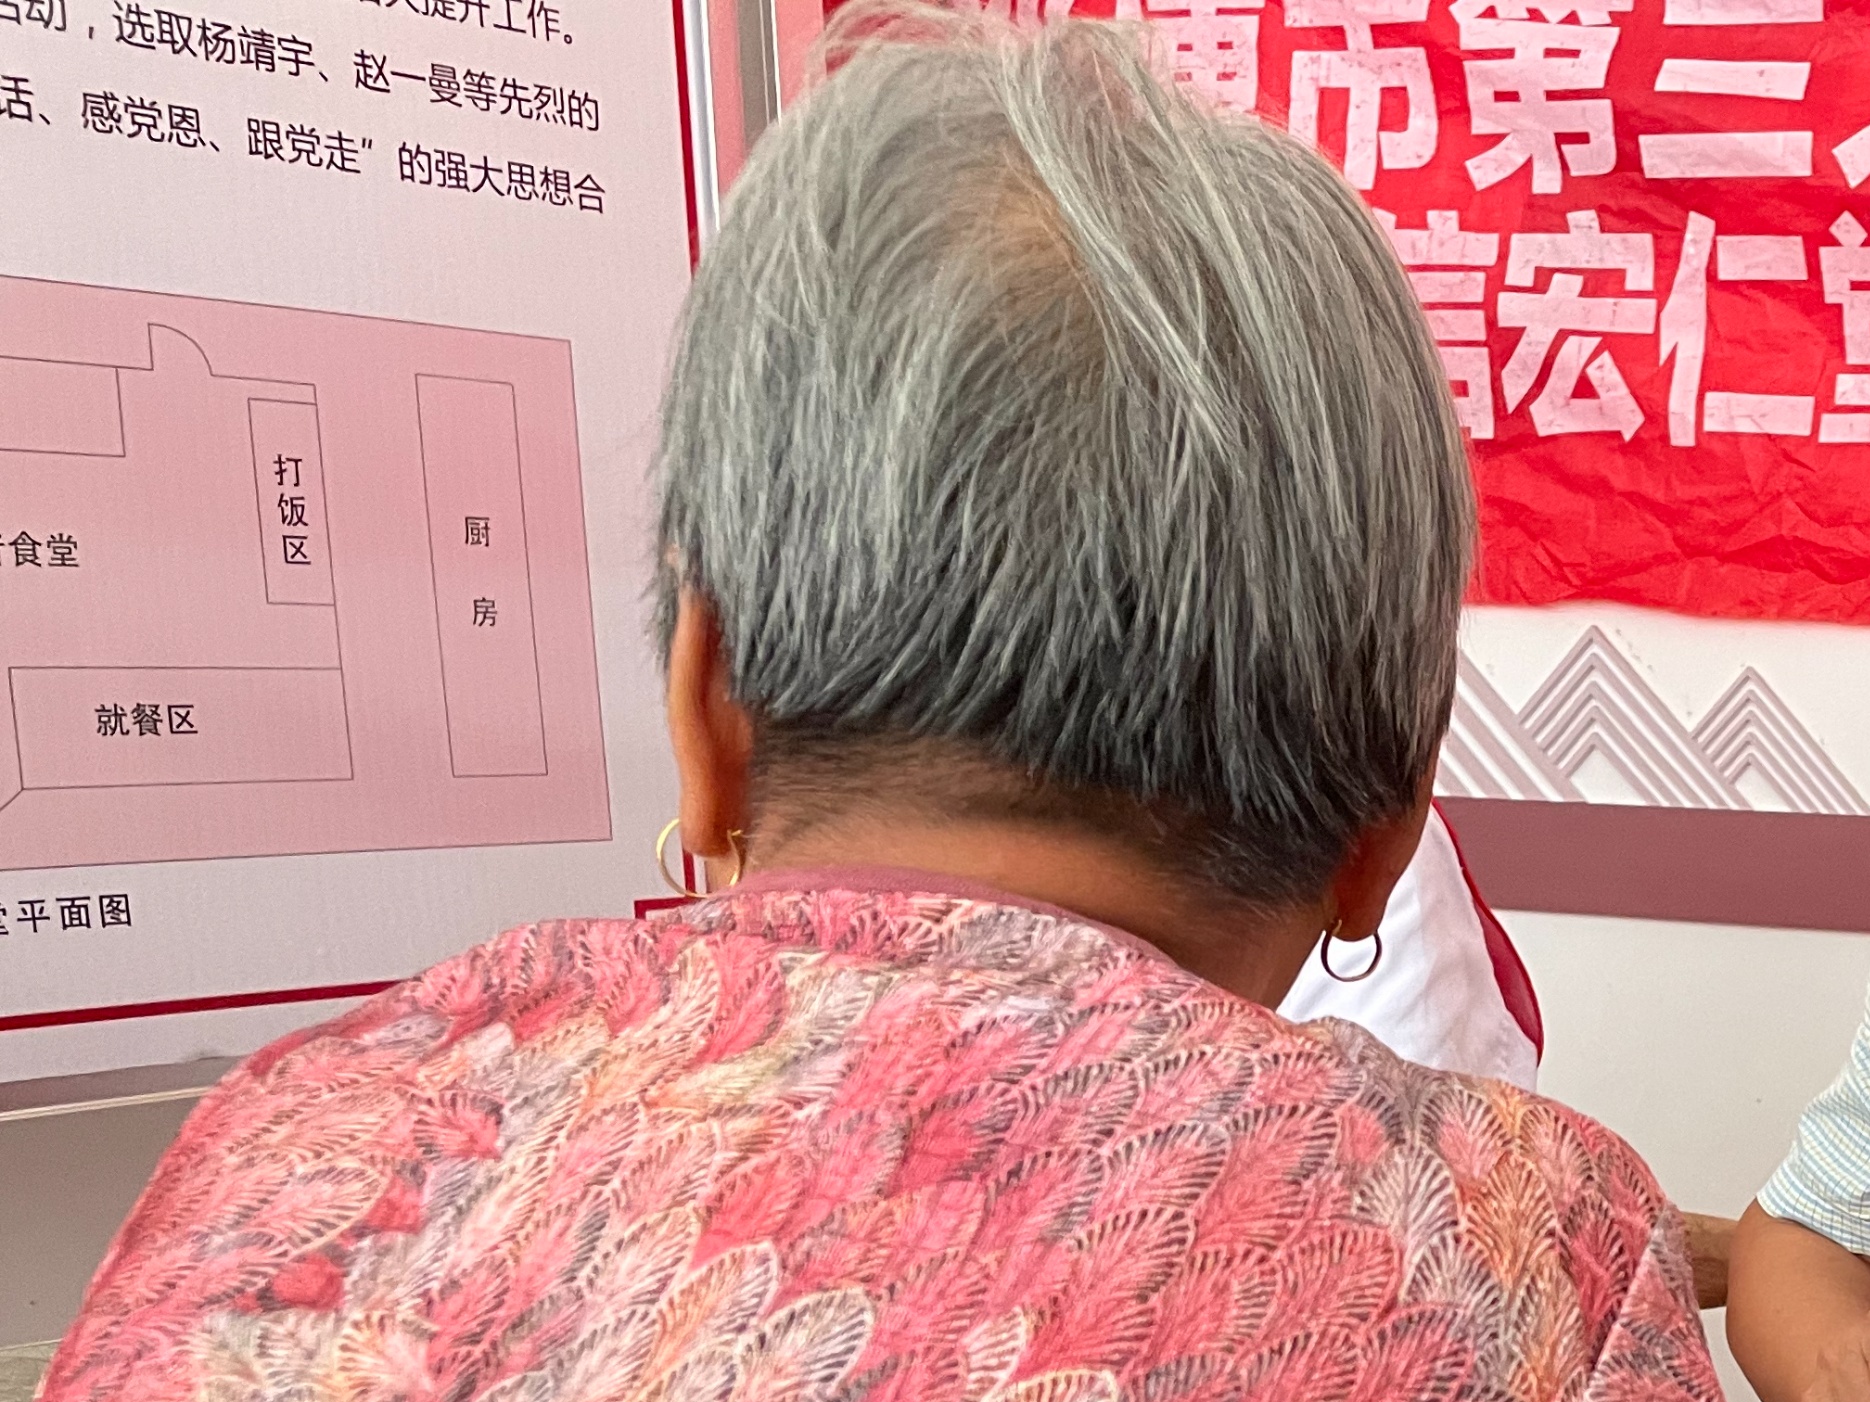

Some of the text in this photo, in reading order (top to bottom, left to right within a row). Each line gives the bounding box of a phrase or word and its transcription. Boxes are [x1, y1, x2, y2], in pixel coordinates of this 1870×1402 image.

[357, 0, 573, 44] 提升工作。
[273, 455, 312, 566] 打饭区
[464, 516, 498, 628] 厨房
[95, 703, 199, 738] 就餐区
[0, 893, 132, 938] 平面图
